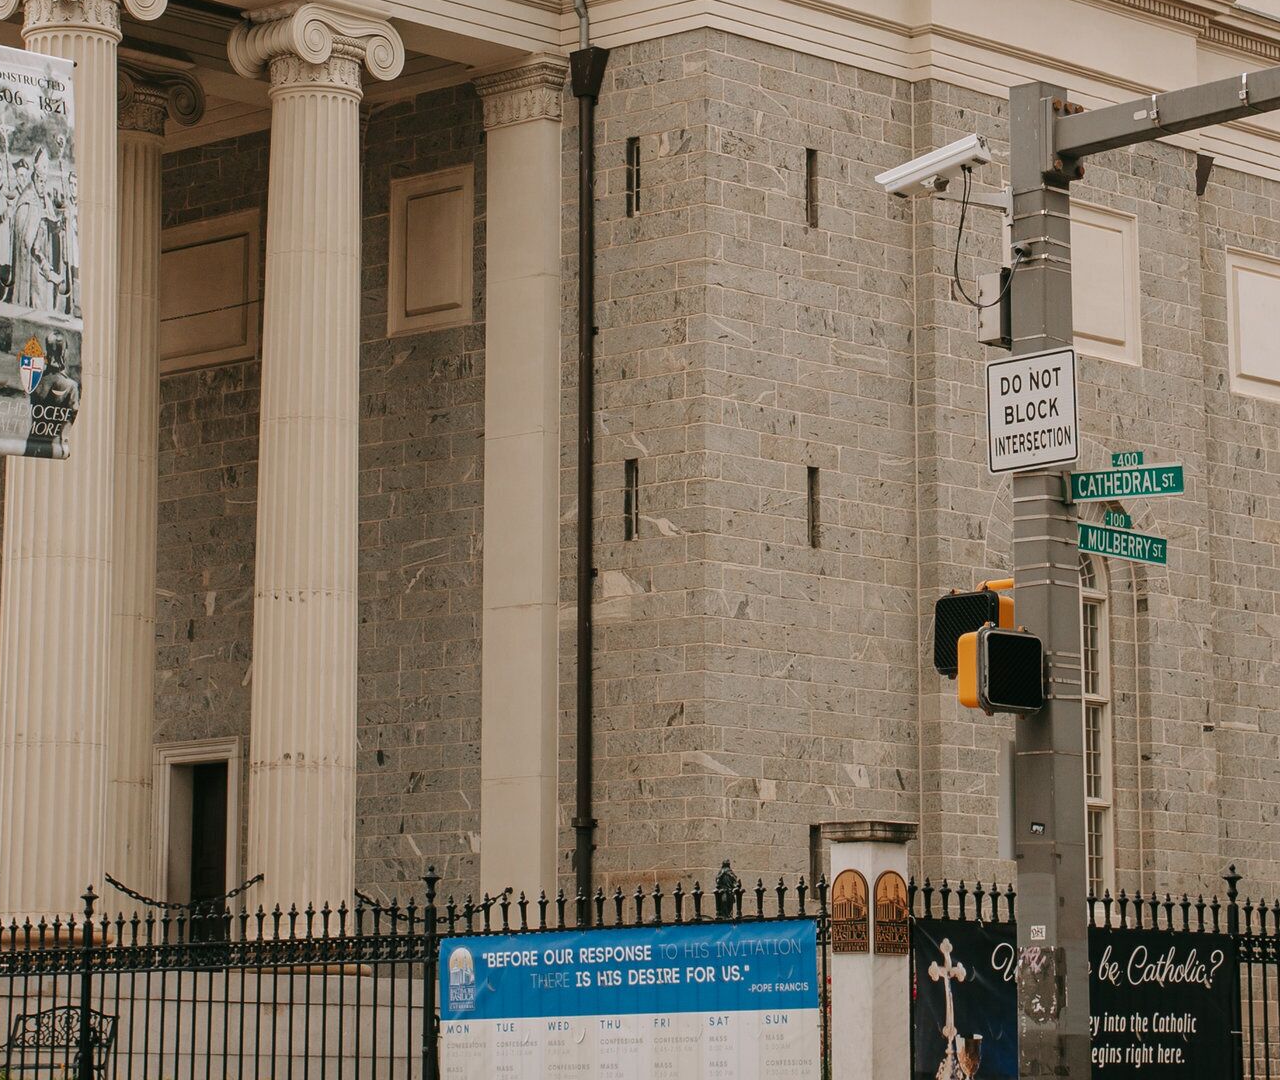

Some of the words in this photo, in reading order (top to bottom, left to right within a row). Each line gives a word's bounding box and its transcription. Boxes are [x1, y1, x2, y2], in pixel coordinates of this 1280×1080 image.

[39, 95, 67, 115] 1821
[1000, 374, 1022, 396] DO
[1029, 367, 1061, 391] NOT
[1005, 397, 1059, 425] BLOCK
[995, 425, 1071, 457] INTERSECTION
[1078, 470, 1161, 497] CATHEDRAL
[1162, 473, 1176, 488] ST.
[1088, 528, 1152, 559] MULBERRY
[1152, 544, 1163, 558] ST.
[482, 950, 538, 968] "BEFORE
[543, 948, 573, 965] OUR
[579, 945, 652, 964] RESPONSE
[658, 943, 677, 960] TO
[684, 942, 710, 959] HIS
[716, 938, 802, 958] INVITATION
[1099, 945, 1120, 980] be
[1127, 945, 1224, 985] Catholic?
[530, 971, 570, 989] THERE
[575, 971, 591, 988] IS
[597, 970, 622, 987] HIS
[628, 967, 680, 985] DESIRE
[686, 966, 715, 983] FOR
[722, 965, 750, 982] US."
[775, 982, 809, 992] FRANCIS
[447, 1024, 470, 1034] MON
[496, 1023, 515, 1032] TUE
[548, 1021, 570, 1031] WED
[600, 1020, 621, 1030] THU
[654, 1018, 670, 1028] FRI
[709, 1016, 730, 1026] SAT
[765, 1014, 788, 1024] SUN
[1104, 1012, 1126, 1032] into
[1130, 1012, 1148, 1032] the
[1152, 1012, 1197, 1033] Catholic
[1091, 1043, 1122, 1068] egins
[1125, 1043, 1153, 1068] right
[1157, 1043, 1185, 1064] here.
